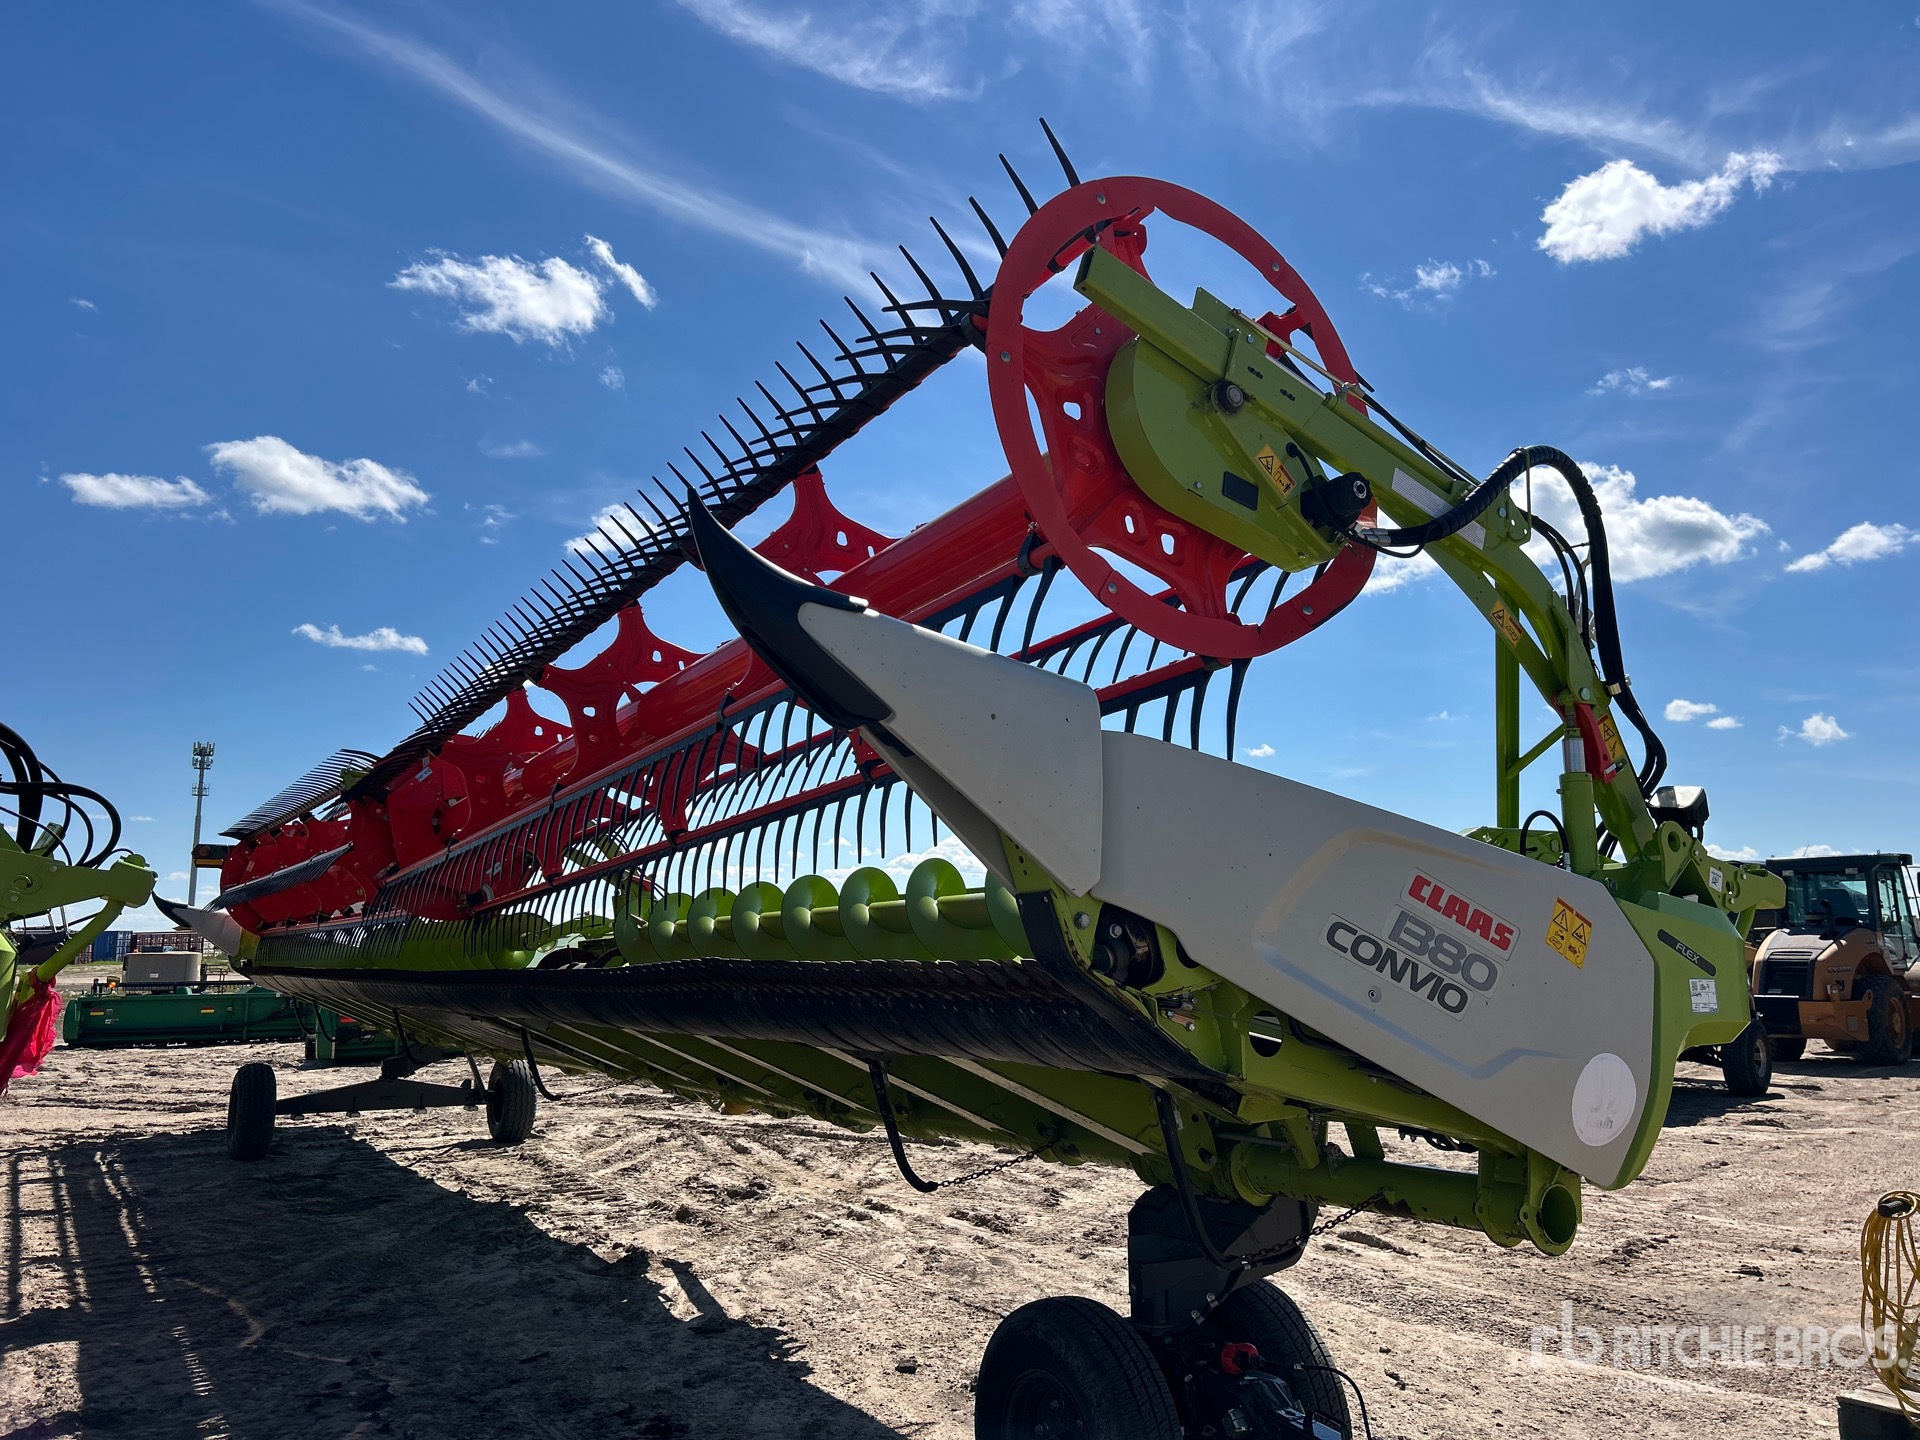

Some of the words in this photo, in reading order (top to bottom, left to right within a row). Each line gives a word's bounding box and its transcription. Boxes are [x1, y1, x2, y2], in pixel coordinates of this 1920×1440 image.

[1408, 874, 1514, 951] CLAAS
[1326, 921, 1469, 1014] CONVIO
[1675, 942, 1700, 965] FLEX
